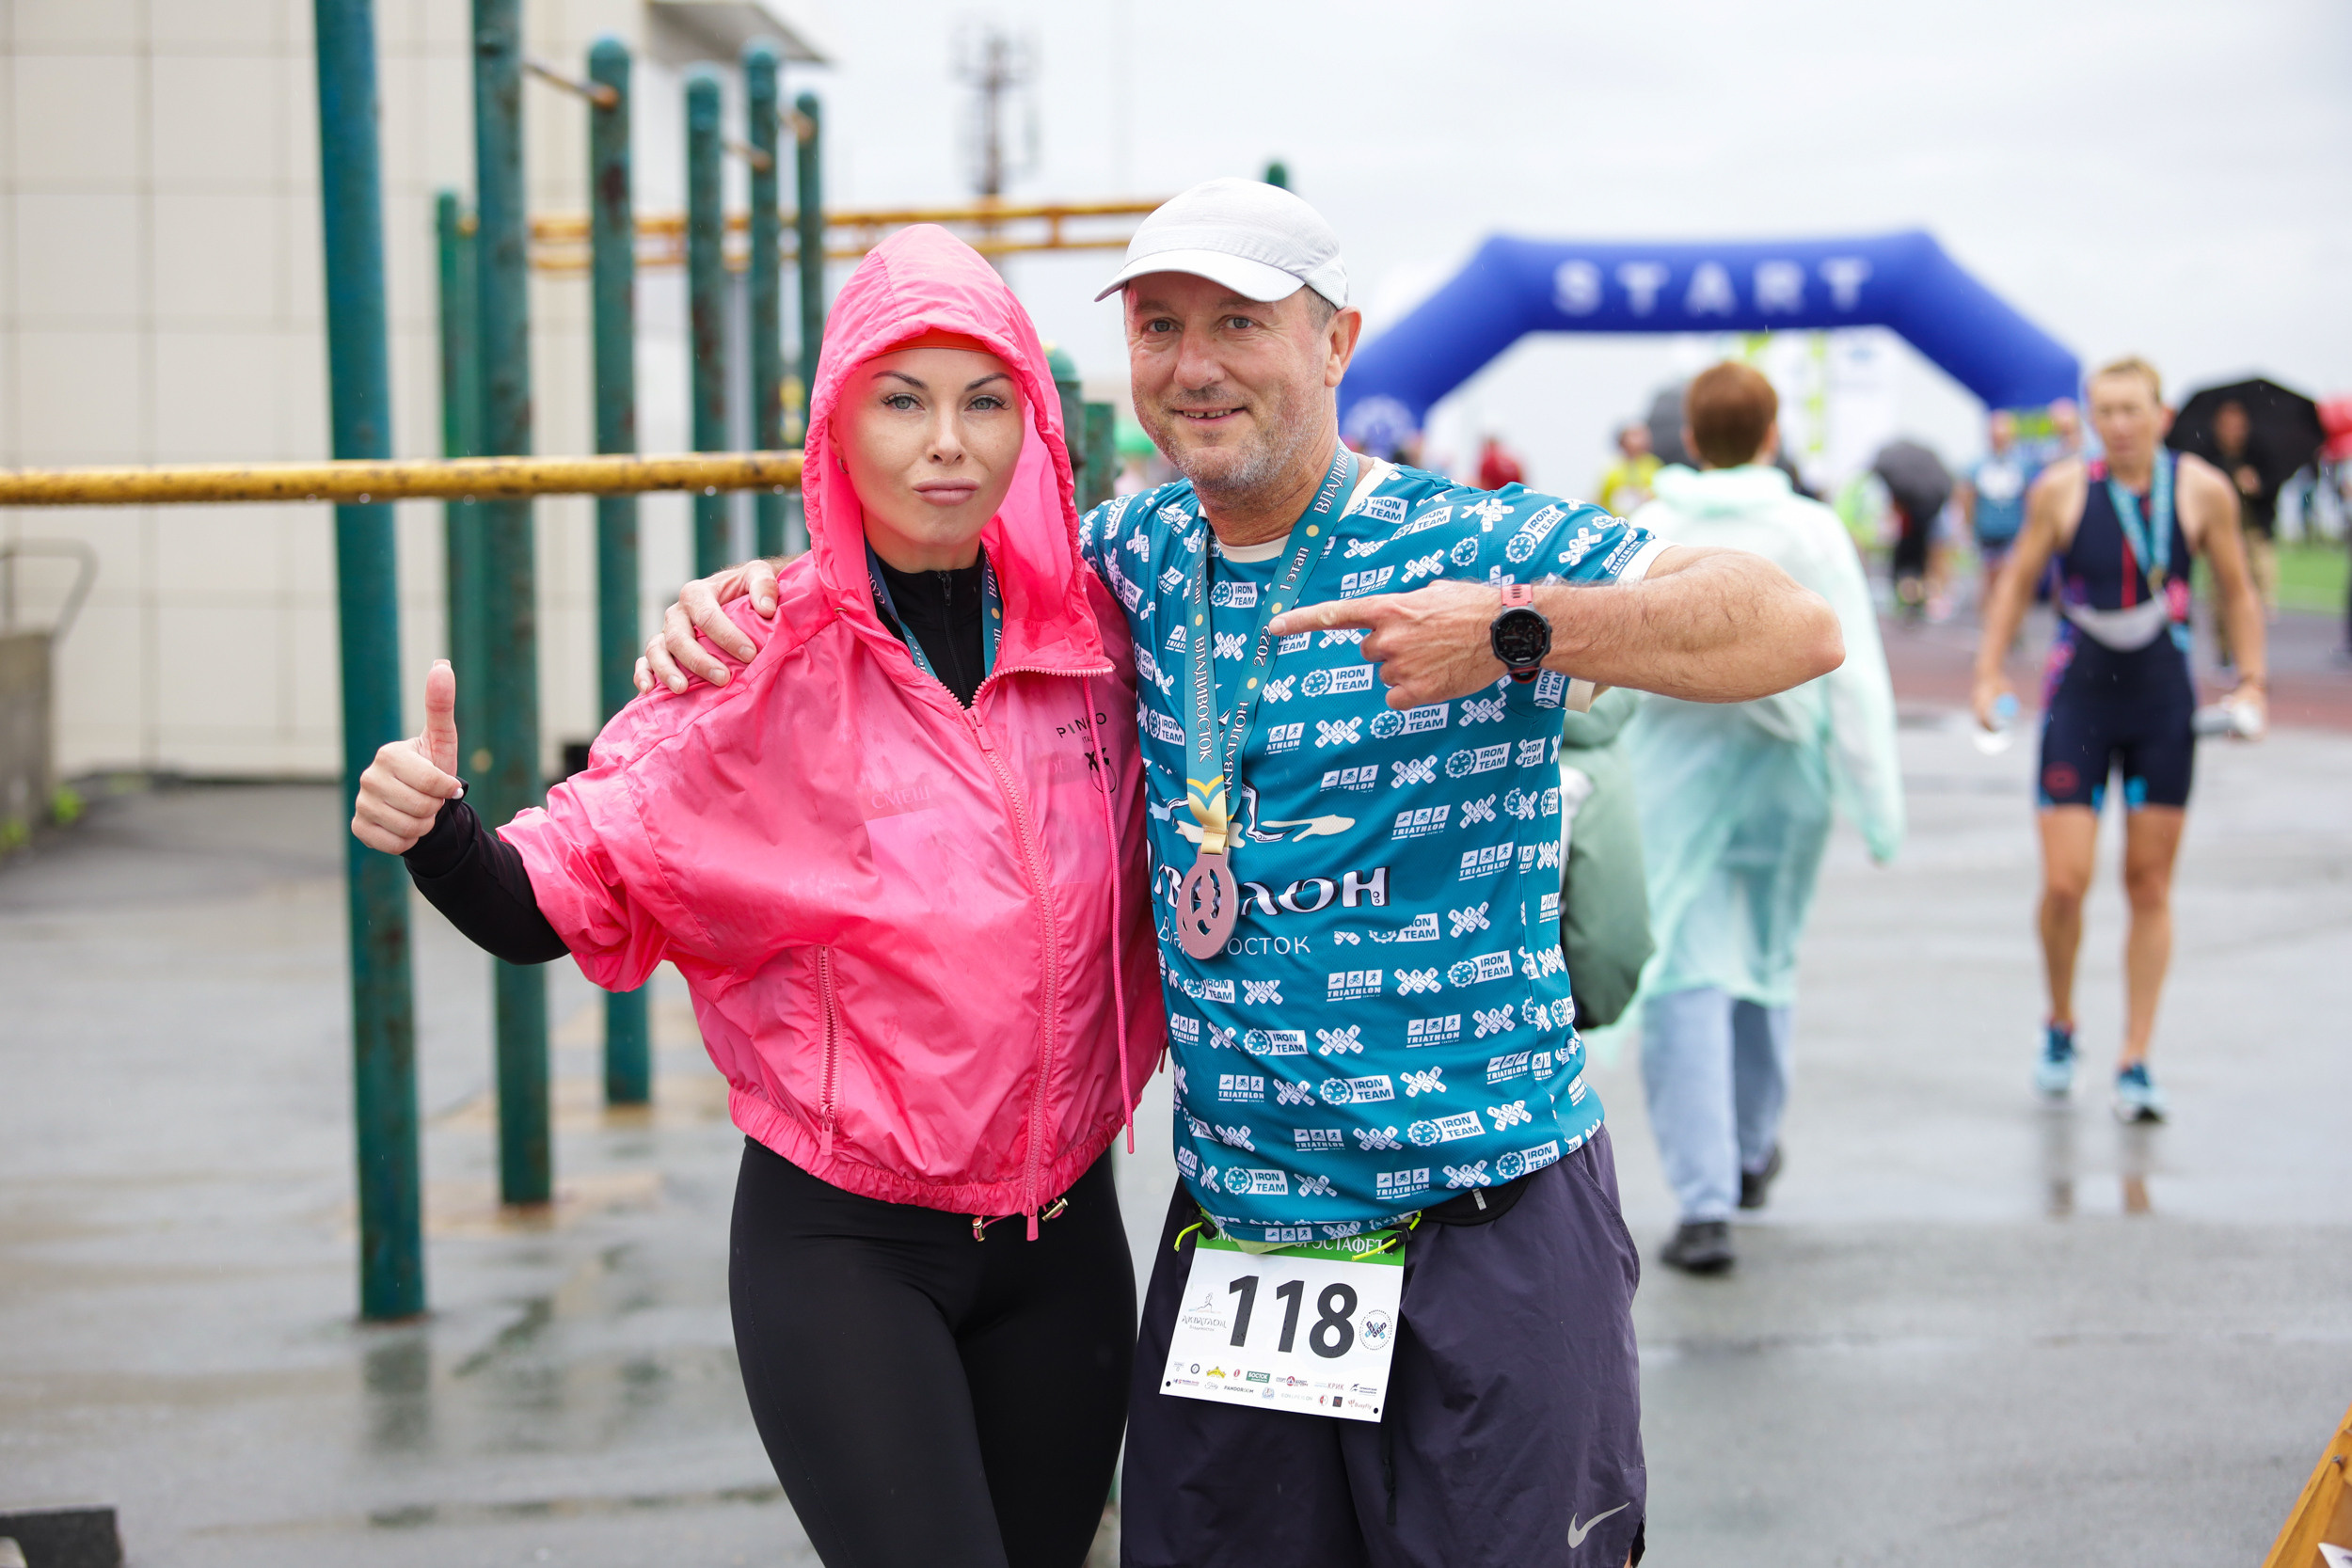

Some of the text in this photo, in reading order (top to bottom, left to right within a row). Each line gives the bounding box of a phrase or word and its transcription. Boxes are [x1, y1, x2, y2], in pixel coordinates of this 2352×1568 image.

[1553, 258, 1873, 317] START
[1373, 498, 1402, 511] IRON
[1370, 506, 1402, 522] TEAM
[1528, 508, 1551, 531] IRON
[1418, 515, 1447, 530] TEAM
[1537, 512, 1562, 534] TEAM
[1280, 546, 1310, 592] 1 этап
[1234, 585, 1253, 594] IRON
[1340, 579, 1389, 598] TRIATHLON
[1234, 596, 1255, 606] TEAM
[1253, 625, 1271, 667] 2022
[1278, 641, 1306, 653] TEAM
[1141, 650, 1153, 666] IRON
[1141, 664, 1153, 677] TEAM
[1336, 669, 1365, 679] IRON
[1336, 680, 1369, 691] TEAM
[1538, 669, 1552, 695] IRON
[1193, 635, 1214, 764] ВЛАДИВОСТОК
[1409, 707, 1440, 721] IRON
[1162, 717, 1180, 731] IRON
[1409, 719, 1444, 732] TEAM
[1161, 730, 1183, 744] TEAM
[1223, 701, 1249, 800] АКВАТЛОН
[1266, 739, 1300, 752] ATHLON
[1480, 747, 1505, 759] IRON
[1479, 758, 1505, 770] TEAM
[871, 785, 930, 809] СМЕШ
[1392, 822, 1446, 836] TRIATHLON
[1459, 859, 1510, 877] TRIATHLON
[1404, 929, 1437, 939] TEAM
[1480, 956, 1504, 966] IRON
[1482, 966, 1510, 978] TEAM
[1206, 979, 1229, 989] IRON
[1208, 990, 1232, 1001] TEAM
[1327, 987, 1381, 998] TRIATHLON
[1273, 1033, 1297, 1042] IRON
[1406, 1031, 1460, 1044] TRIATHLON
[1276, 1044, 1305, 1053] TEAM
[1486, 1064, 1528, 1081] TRIATHLON
[1354, 1079, 1383, 1089] IRON
[1358, 1089, 1391, 1101] TEAM
[1441, 1116, 1471, 1128] IRON
[1446, 1125, 1481, 1139] TEAM
[1527, 1146, 1552, 1160] IRON
[1529, 1156, 1557, 1171] TEAM
[1255, 1172, 1280, 1181] IRON
[1256, 1183, 1286, 1193] TEAM
[1375, 1183, 1430, 1196] TRIATHLON
[1229, 1275, 1358, 1359] 118
